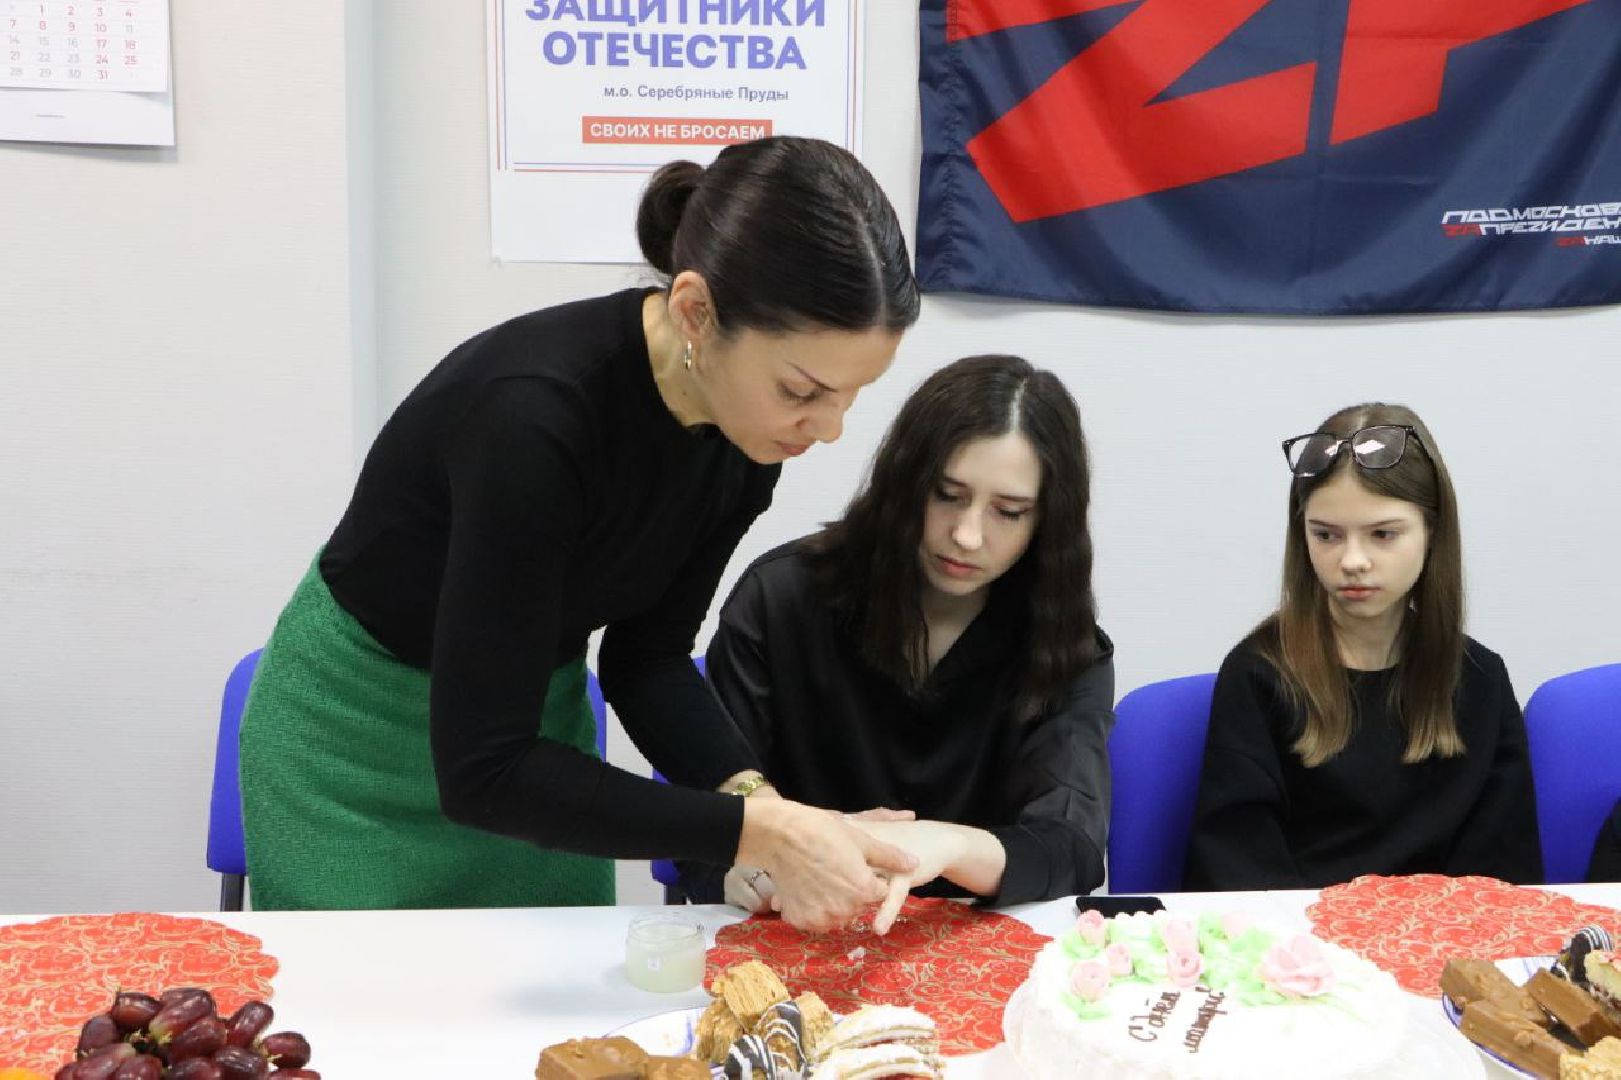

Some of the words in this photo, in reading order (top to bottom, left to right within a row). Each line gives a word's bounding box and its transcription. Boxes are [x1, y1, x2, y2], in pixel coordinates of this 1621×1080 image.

[40, 5, 44, 14] 1
[67, 6, 75, 16] 2
[97, 7, 104, 17] 3
[125, 8, 132, 17] 4
[525, 0, 825, 27] ЗАЩИТНИКИ
[10, 19, 16, 29] 7
[40, 20, 47, 31] 8
[68, 22, 75, 32] 9
[95, 23, 107, 32] 10
[126, 24, 133, 33] 11
[9, 35, 20, 44] 14
[39, 36, 49, 46] 15
[67, 38, 79, 48] 16
[97, 39, 107, 49] 17
[125, 40, 136, 50] 18
[10, 51, 20, 61] 21
[39, 53, 51, 63] 22
[67, 54, 80, 64] 23
[96, 55, 108, 65] 24
[124, 55, 137, 65] 25
[543, 31, 807, 70] ОТЕЧЕСТВА
[10, 67, 22, 77] 28
[39, 68, 51, 78] 29
[68, 69, 81, 79] 30
[98, 70, 108, 80] 31
[604, 86, 632, 98] м.о.
[638, 84, 734, 102] Серебряные
[738, 86, 789, 103] Пруды
[590, 122, 650, 138] СВОИХ
[654, 123, 677, 139] НЕ
[680, 123, 765, 140] БРОСАЕМ
